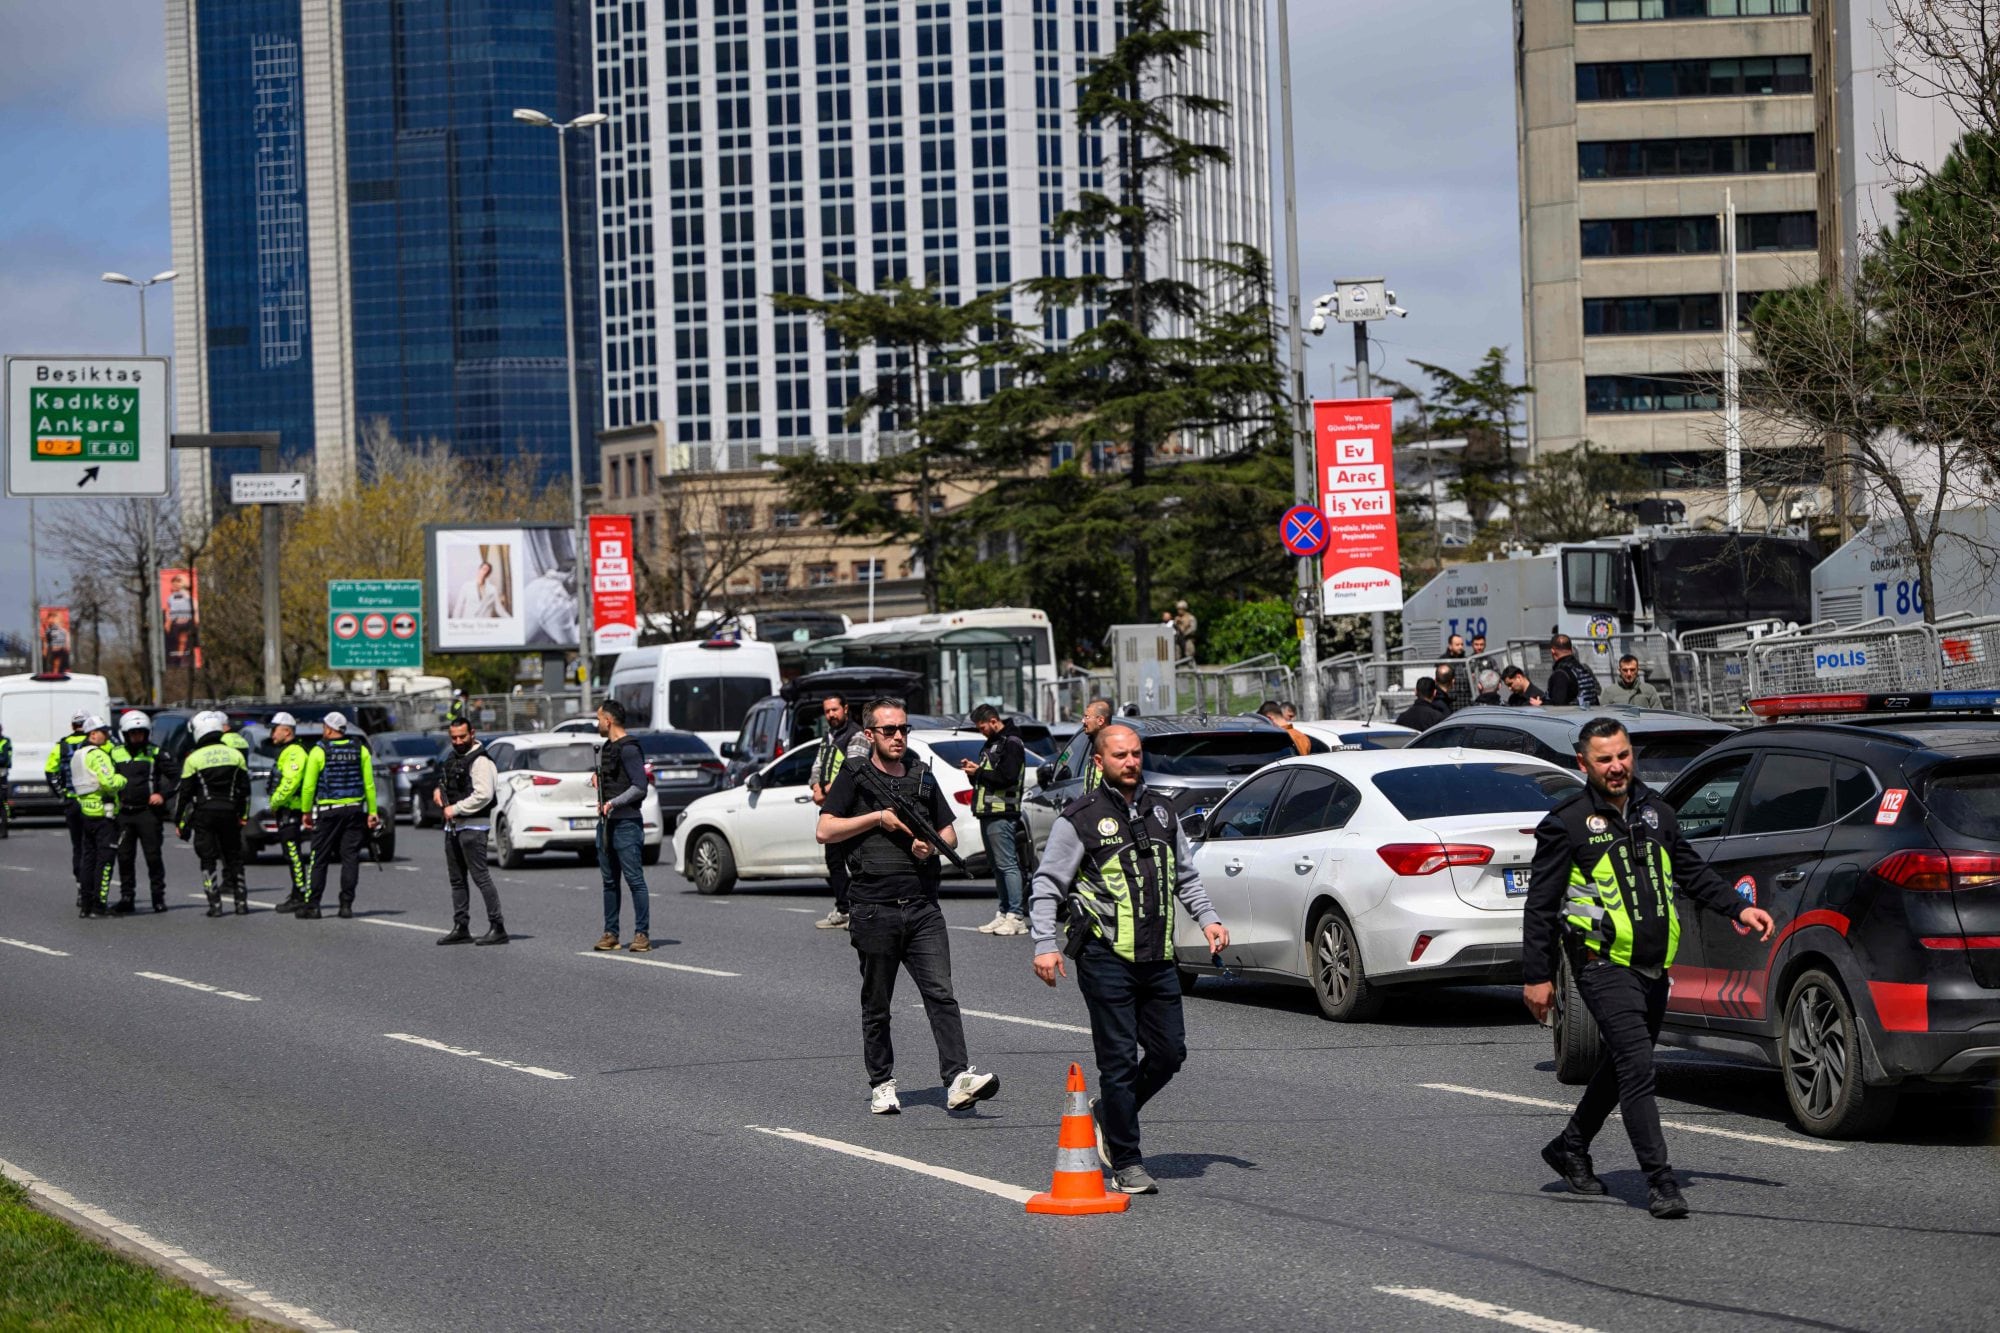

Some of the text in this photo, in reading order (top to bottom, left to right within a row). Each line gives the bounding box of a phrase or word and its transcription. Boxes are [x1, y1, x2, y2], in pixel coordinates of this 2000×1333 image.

[37, 366, 142, 383] Beşiktaş
[36, 393, 134, 414] Kadıköy
[37, 416, 125, 432] Ankara
[1344, 445, 1365, 458] Ev
[1337, 470, 1376, 485] Araç
[1332, 496, 1384, 515] İş Yeri
[1870, 559, 1900, 571] GÖKHAN
[1874, 583, 1887, 616] T
[1449, 618, 1459, 636] T
[1816, 651, 1866, 669] POLİS
[331, 753, 357, 761] POLİS
[1883, 793, 1903, 810] 112
[1100, 836, 1123, 846] POLİS
[1588, 833, 1614, 845] POLİS
